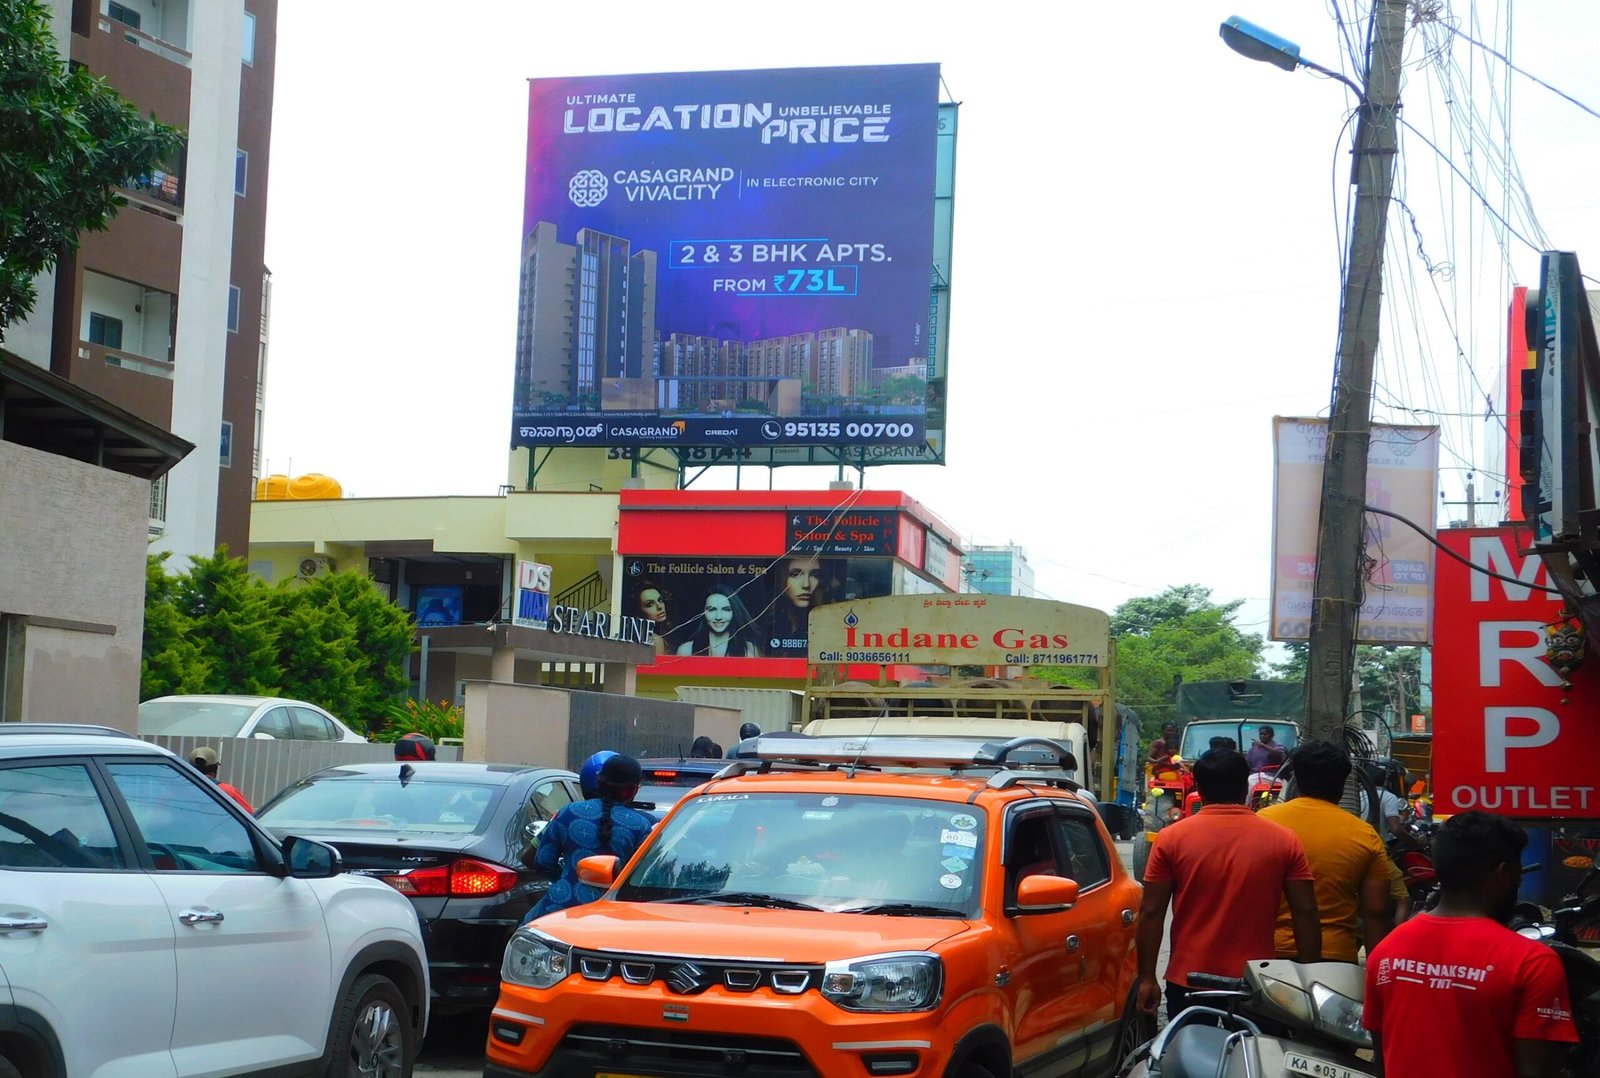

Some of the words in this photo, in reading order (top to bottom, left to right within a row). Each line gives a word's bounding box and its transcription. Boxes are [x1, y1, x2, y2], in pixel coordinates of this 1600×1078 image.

[566, 93, 636, 105] ULTIMATE
[563, 102, 773, 134] LOCATION
[779, 104, 892, 117] UNBELIEVABLE
[761, 116, 892, 145] PRICE
[613, 167, 735, 184] CASAGRAND
[747, 178, 759, 187] IN
[763, 176, 845, 187] ELECTRONIC
[849, 176, 879, 186] CITY
[625, 184, 722, 202] VIVACITY
[680, 245, 695, 263] 2
[703, 244, 720, 263] &
[728, 244, 743, 263] 3
[752, 243, 808, 262] BHK
[816, 243, 893, 262] APTS.
[713, 278, 766, 292] FROM
[610, 427, 679, 437] CASAGRAND
[784, 422, 841, 437] 95135
[846, 422, 914, 438] 00700
[807, 515, 829, 526] The
[834, 515, 880, 526] Follicle
[794, 530, 830, 541] Salon
[834, 531, 846, 541] &
[850, 531, 875, 543] Spa
[523, 563, 551, 592] DS
[647, 563, 666, 574] The
[668, 563, 704, 574] Follicle
[706, 563, 735, 574] Salon
[737, 564, 747, 574] &
[748, 564, 768, 576] Spa
[521, 590, 549, 621] MAX
[552, 604, 656, 646] STARLINE
[844, 626, 979, 649] Indane
[992, 628, 1069, 650] Gas
[819, 651, 843, 662] Call:
[846, 652, 910, 662] 9036656111
[1005, 653, 1029, 664] Call:
[1033, 653, 1098, 664] 8711961771
[1451, 784, 1594, 810] OUTLET
[1392, 957, 1486, 983] MEENAKSHI
[1429, 978, 1452, 989] TNT
[1291, 1057, 1308, 1071] KA
[1322, 1066, 1337, 1078] 03
